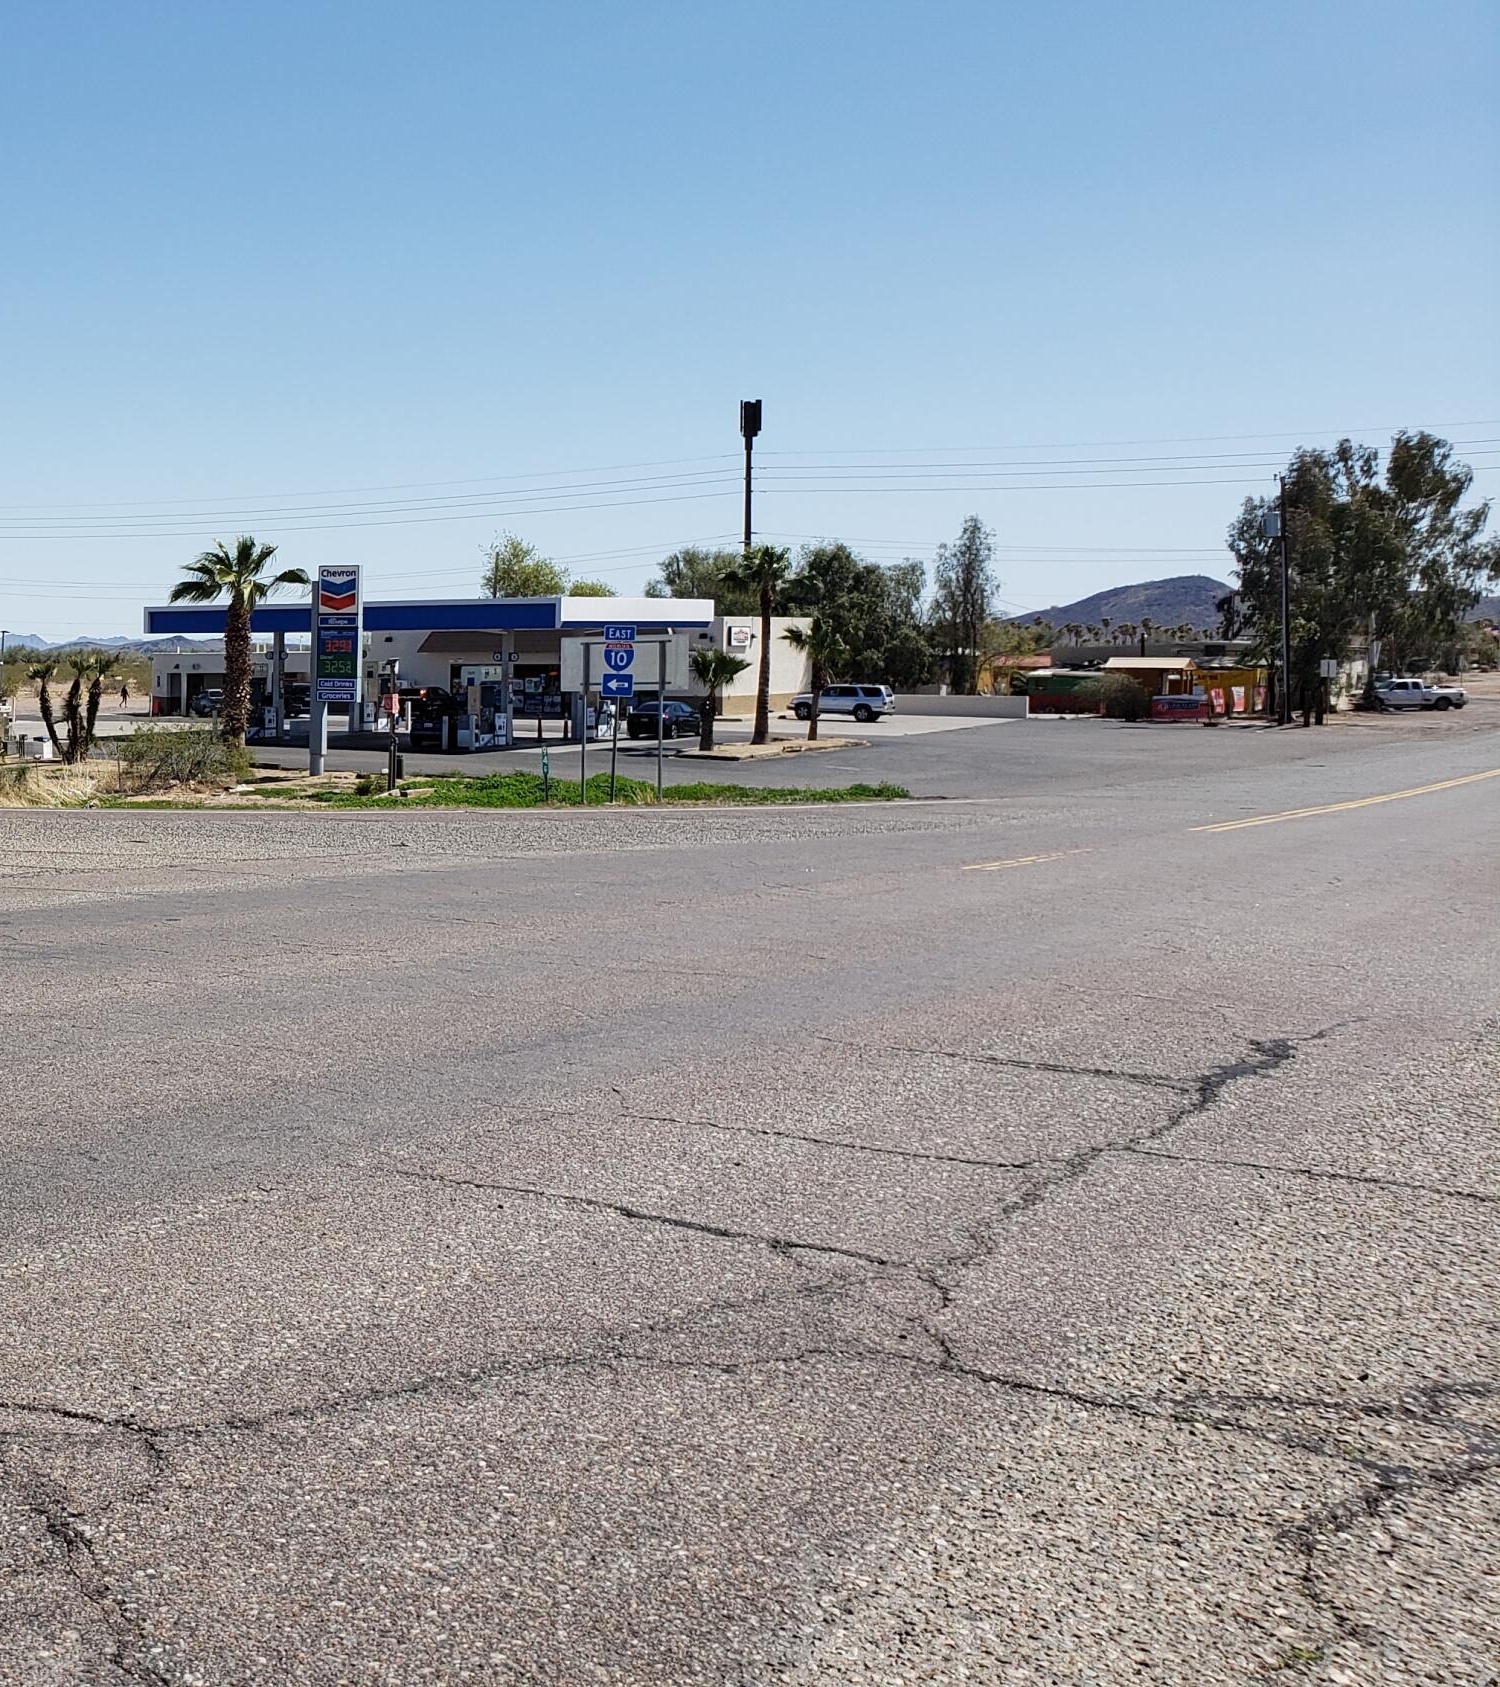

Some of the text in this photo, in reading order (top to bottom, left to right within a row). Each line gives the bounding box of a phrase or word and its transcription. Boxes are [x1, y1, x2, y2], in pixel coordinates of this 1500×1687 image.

[321, 569, 357, 578] Chevron
[609, 628, 631, 639] EAST
[611, 651, 627, 666] 10
[321, 692, 351, 700] Groceries
